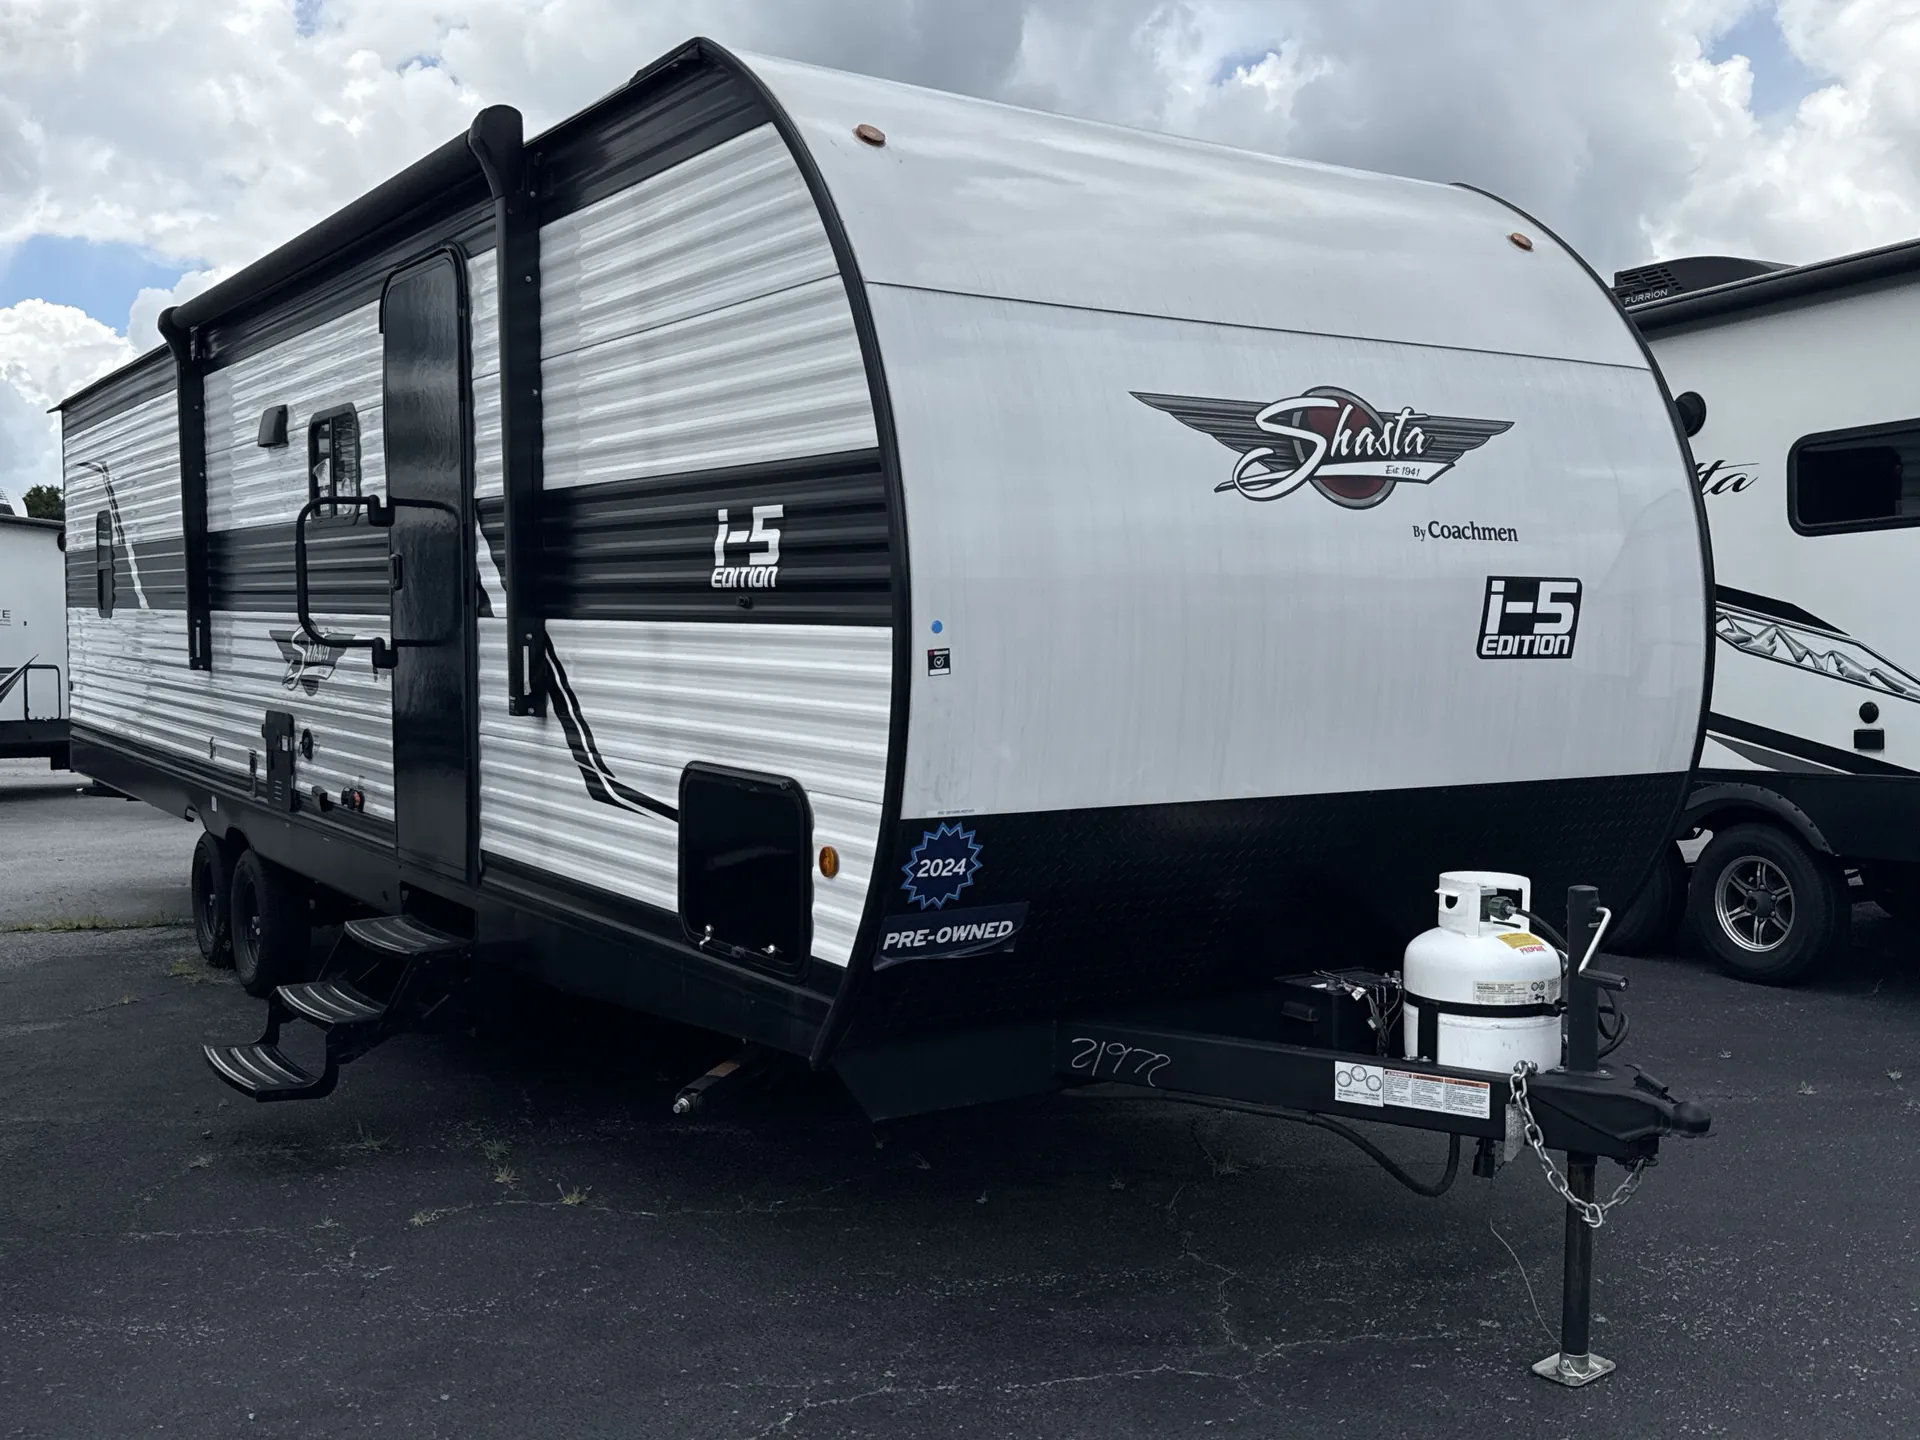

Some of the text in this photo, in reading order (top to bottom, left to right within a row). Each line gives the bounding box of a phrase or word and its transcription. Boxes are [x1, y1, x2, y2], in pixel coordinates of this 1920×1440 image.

[1624, 288, 1668, 305] FURRION
[1231, 396, 1436, 501] Shasta
[1402, 466, 1421, 477] 1941
[714, 504, 784, 566] i-5
[1412, 520, 1519, 542] By Coachmen
[711, 566, 778, 588] EDITION
[1485, 580, 1578, 635] i-5
[1481, 635, 1571, 655] EDITION
[916, 857, 967, 878] 2024
[882, 920, 1014, 951] PRE-OWNED
[1071, 1037, 1171, 1088] 21972
